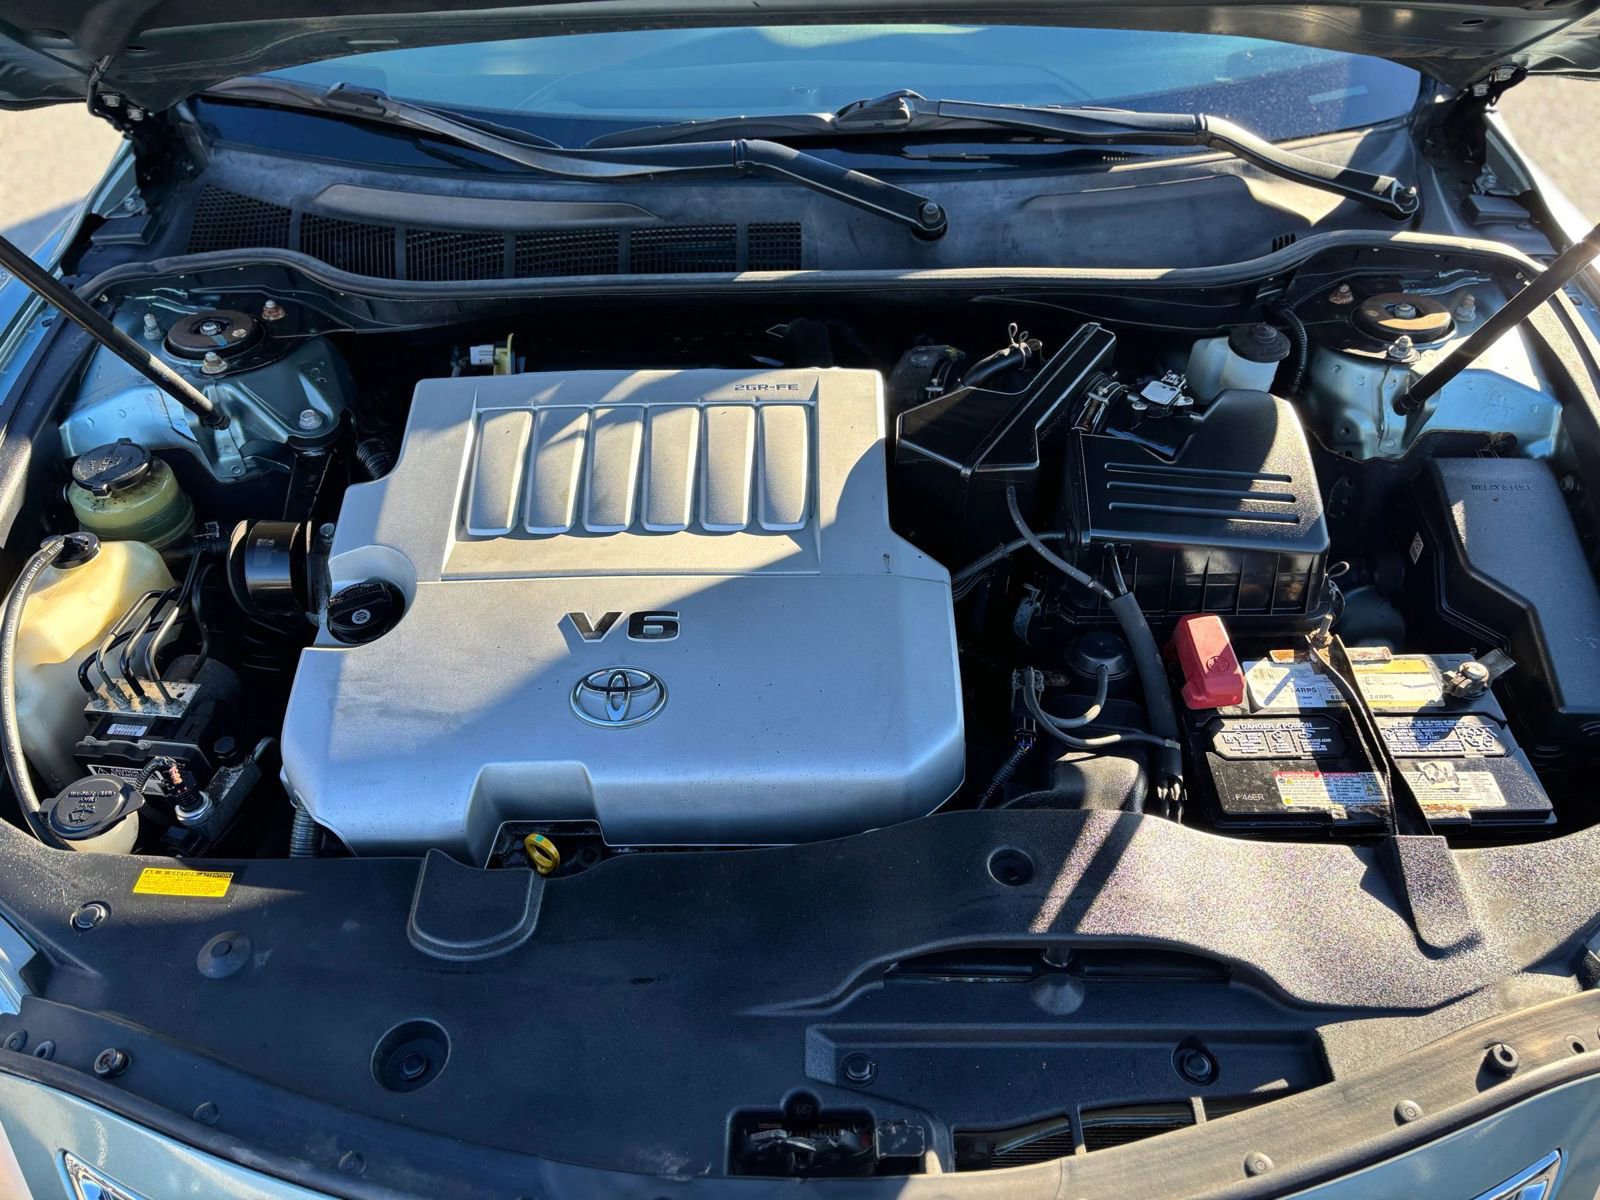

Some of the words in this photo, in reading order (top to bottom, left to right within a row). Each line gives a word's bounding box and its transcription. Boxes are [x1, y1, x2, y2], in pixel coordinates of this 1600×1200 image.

[734, 383, 800, 392] 2GR-FE
[565, 610, 681, 643] V6
[1240, 721, 1275, 730] DANGER
[1281, 721, 1313, 729] POISON
